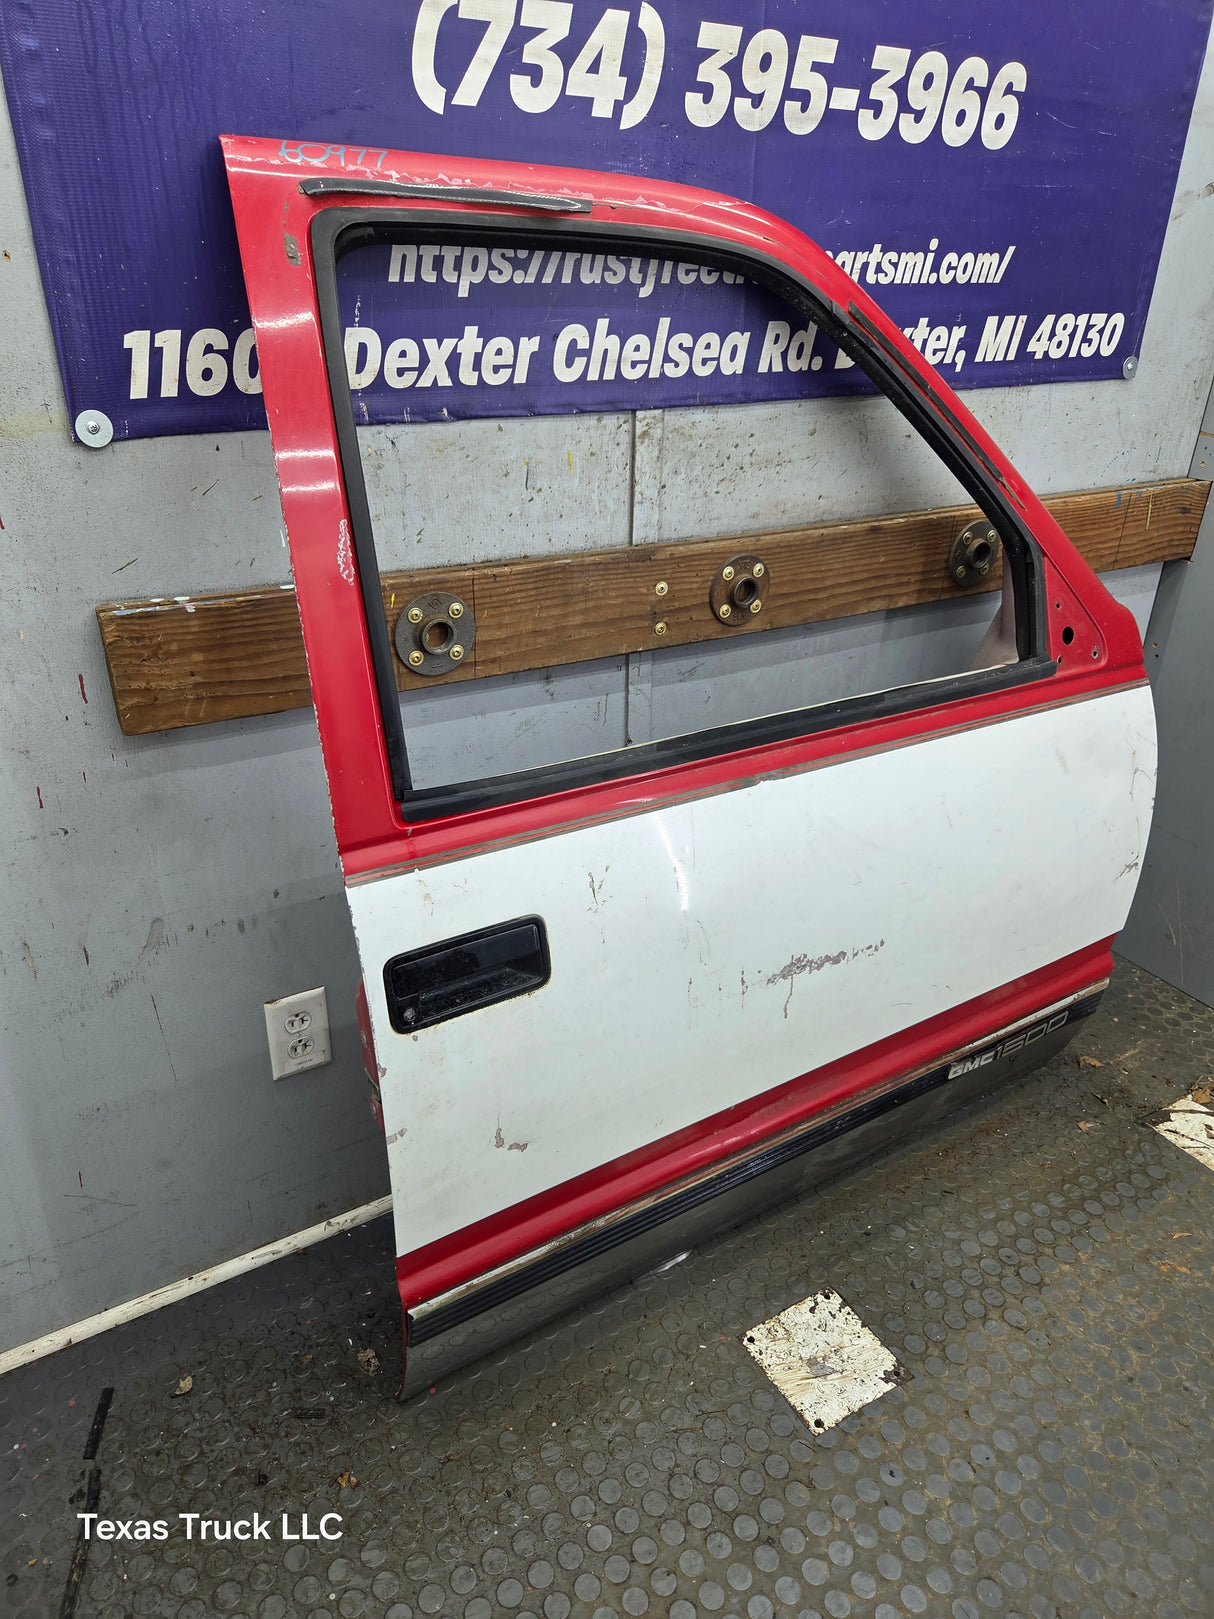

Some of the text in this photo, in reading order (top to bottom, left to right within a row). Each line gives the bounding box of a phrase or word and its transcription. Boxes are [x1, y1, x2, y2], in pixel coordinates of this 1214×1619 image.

[411, 0, 1028, 150] (734) 395-3966
[344, 325, 541, 390] Dexter
[553, 317, 751, 383] Chelsea
[757, 320, 823, 374] Rd.
[974, 315, 1028, 363] MI
[1026, 312, 1126, 360] 48130
[948, 1050, 996, 1080] GMC
